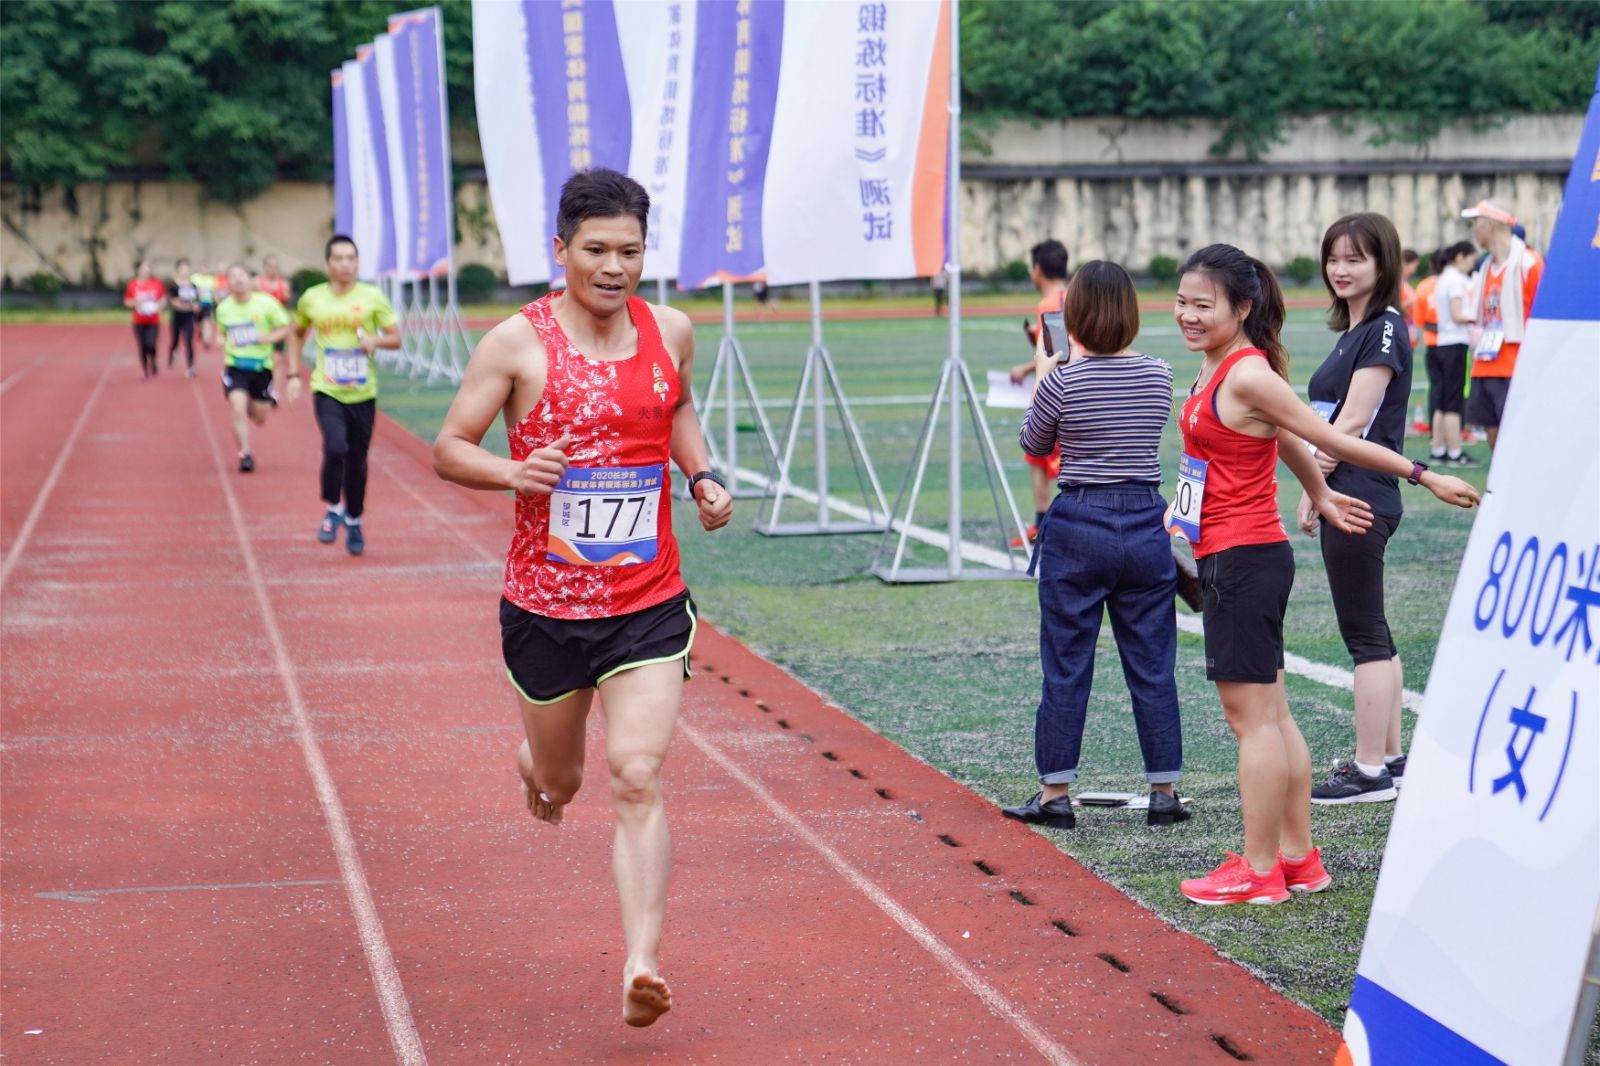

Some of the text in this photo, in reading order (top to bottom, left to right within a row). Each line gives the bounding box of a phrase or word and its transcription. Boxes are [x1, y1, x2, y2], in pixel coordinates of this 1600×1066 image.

[1381, 320, 1393, 354] RUN
[591, 471, 637, 480] 2020长沙市
[576, 497, 646, 538] 177
[1474, 530, 1600, 664] 800米
